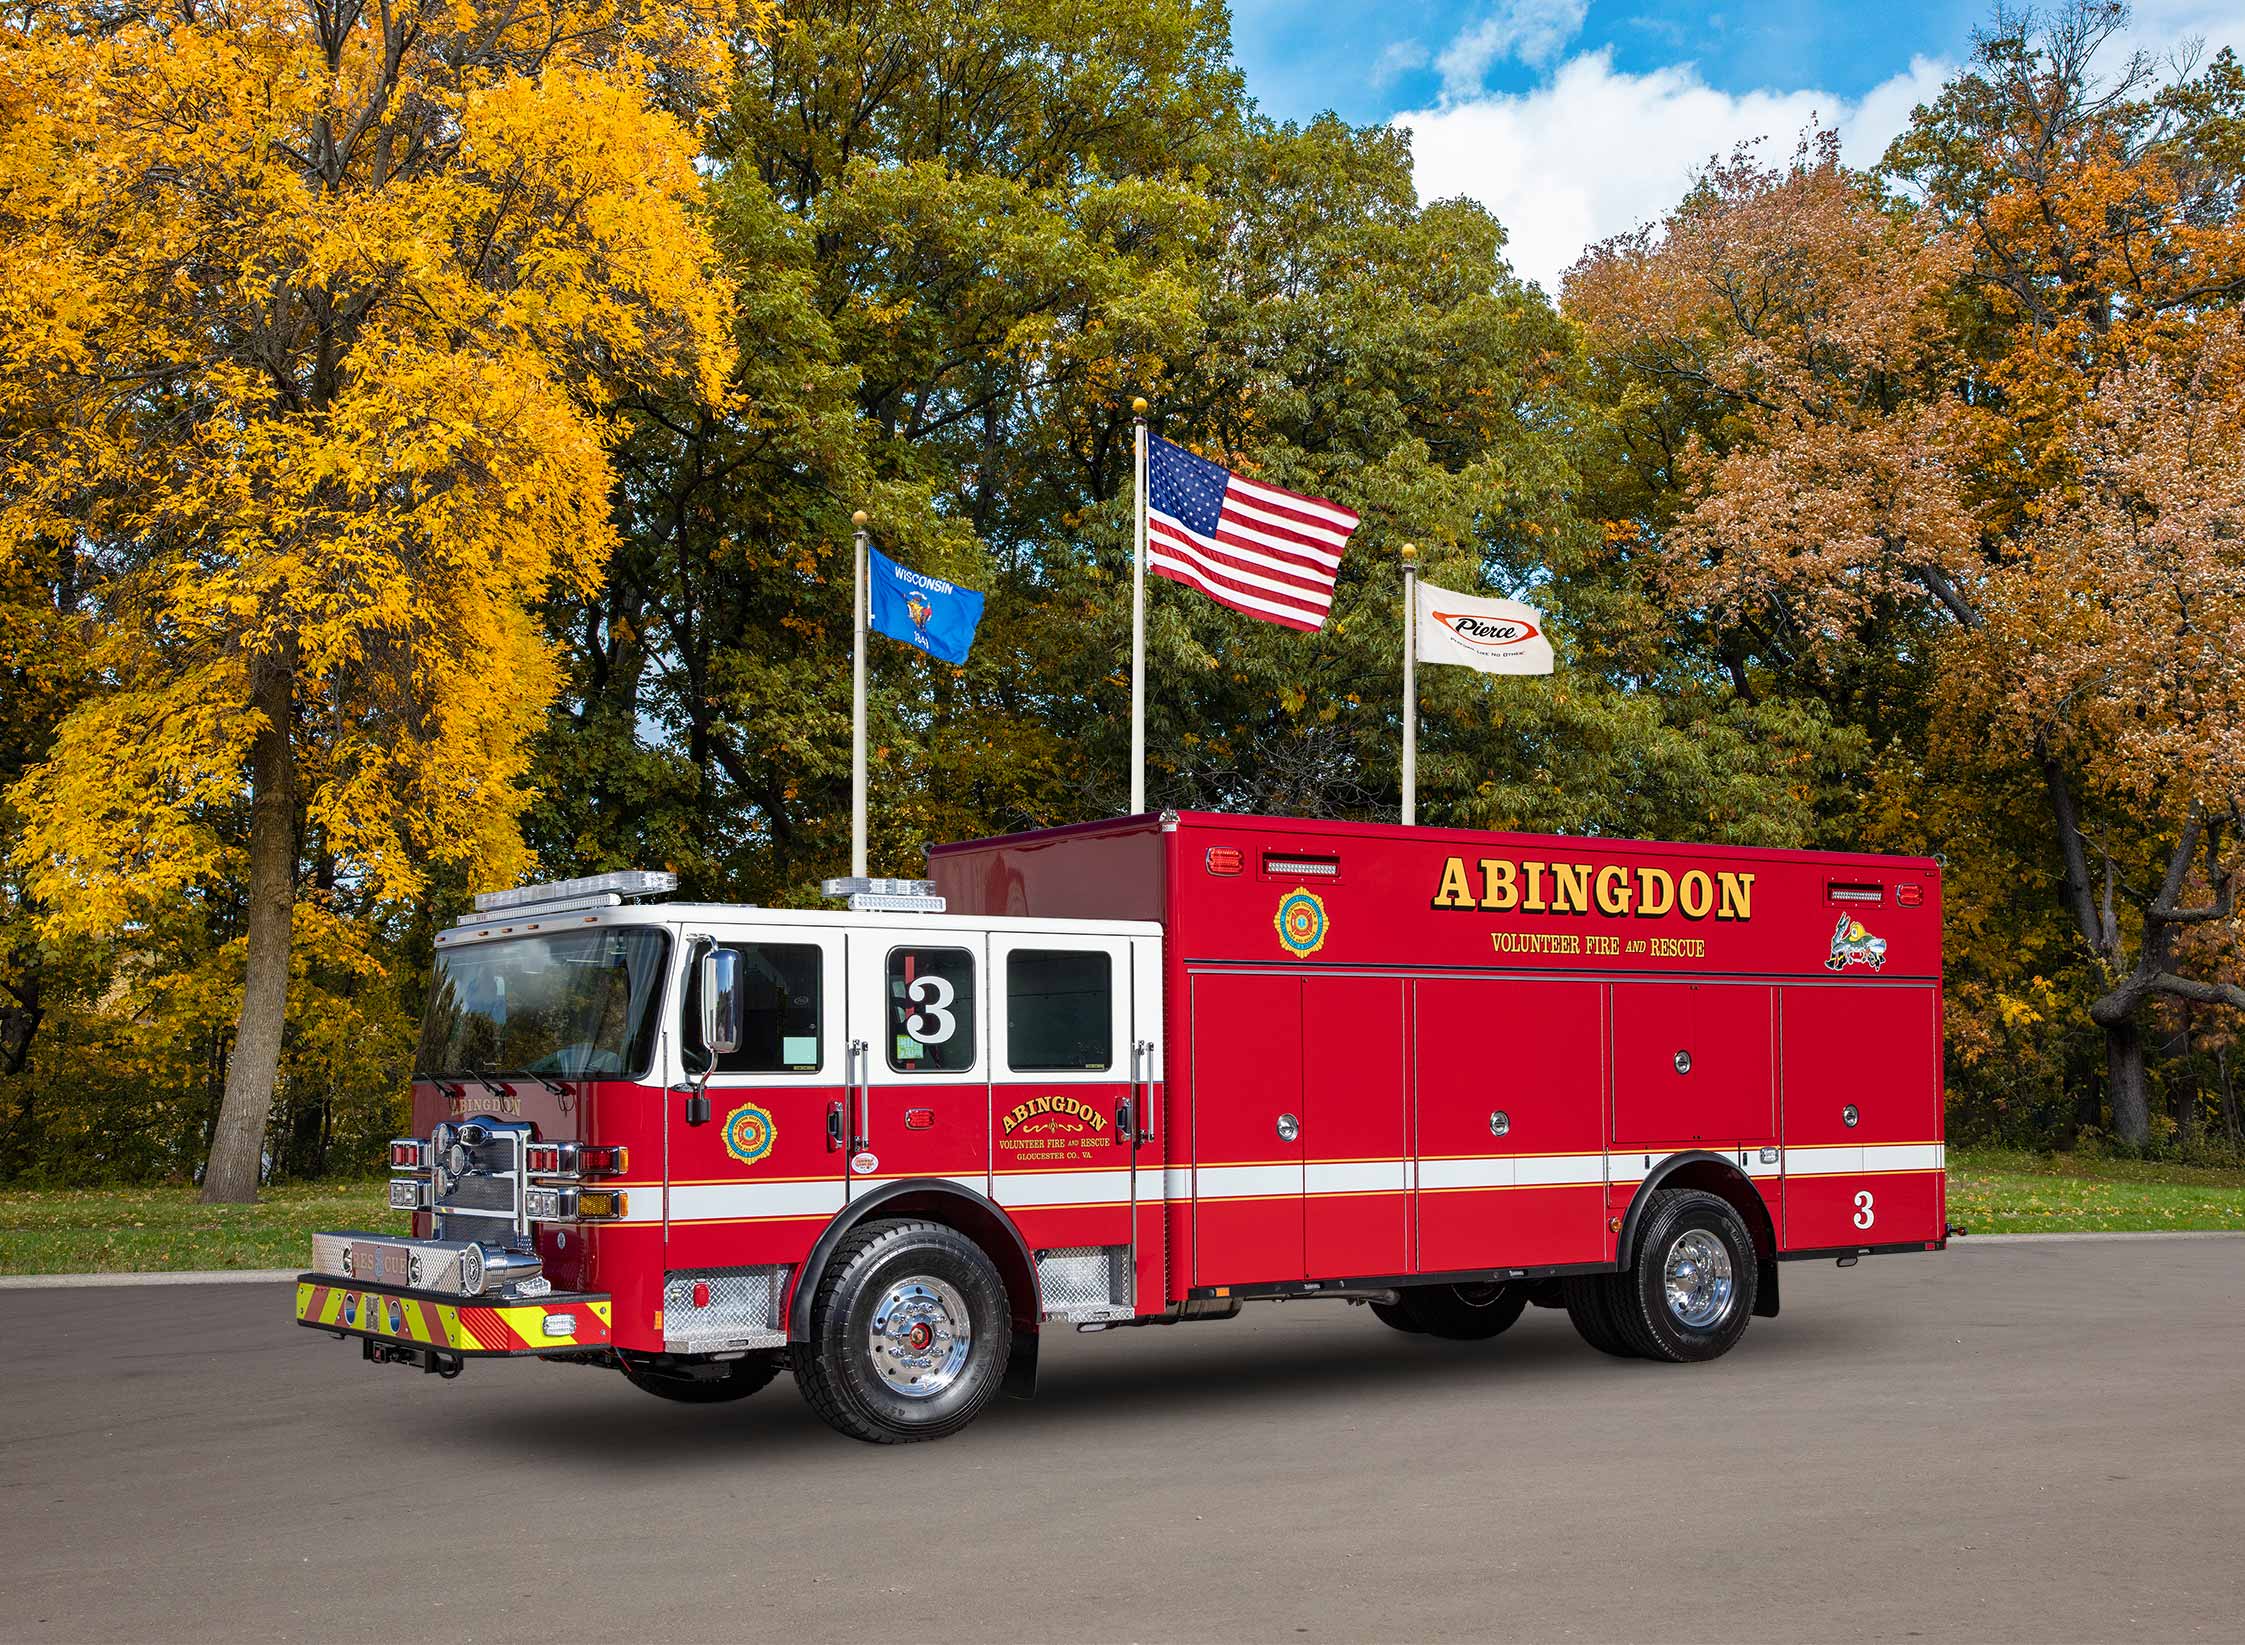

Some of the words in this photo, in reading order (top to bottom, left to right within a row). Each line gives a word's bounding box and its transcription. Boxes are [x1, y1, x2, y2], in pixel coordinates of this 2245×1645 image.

[895, 566, 953, 595] WISCONSIN
[1455, 618, 1516, 638] Pierce
[1431, 857, 1755, 922] ABINGDON
[1491, 932, 1580, 954] VOLUNTEER
[1585, 935, 1620, 956] FIRE
[1625, 940, 1647, 953] AND
[1650, 938, 1705, 958] RESCUE
[907, 976, 956, 1044] 3
[1002, 1096, 1108, 1136] ABINGDON
[1000, 1139, 1044, 1149] VOLUNTEER
[1047, 1139, 1065, 1148] FIRE
[1081, 1138, 1110, 1148] RESCUE
[1017, 1152, 1064, 1160] GLOUCESTER
[1853, 1190, 1875, 1230] 3
